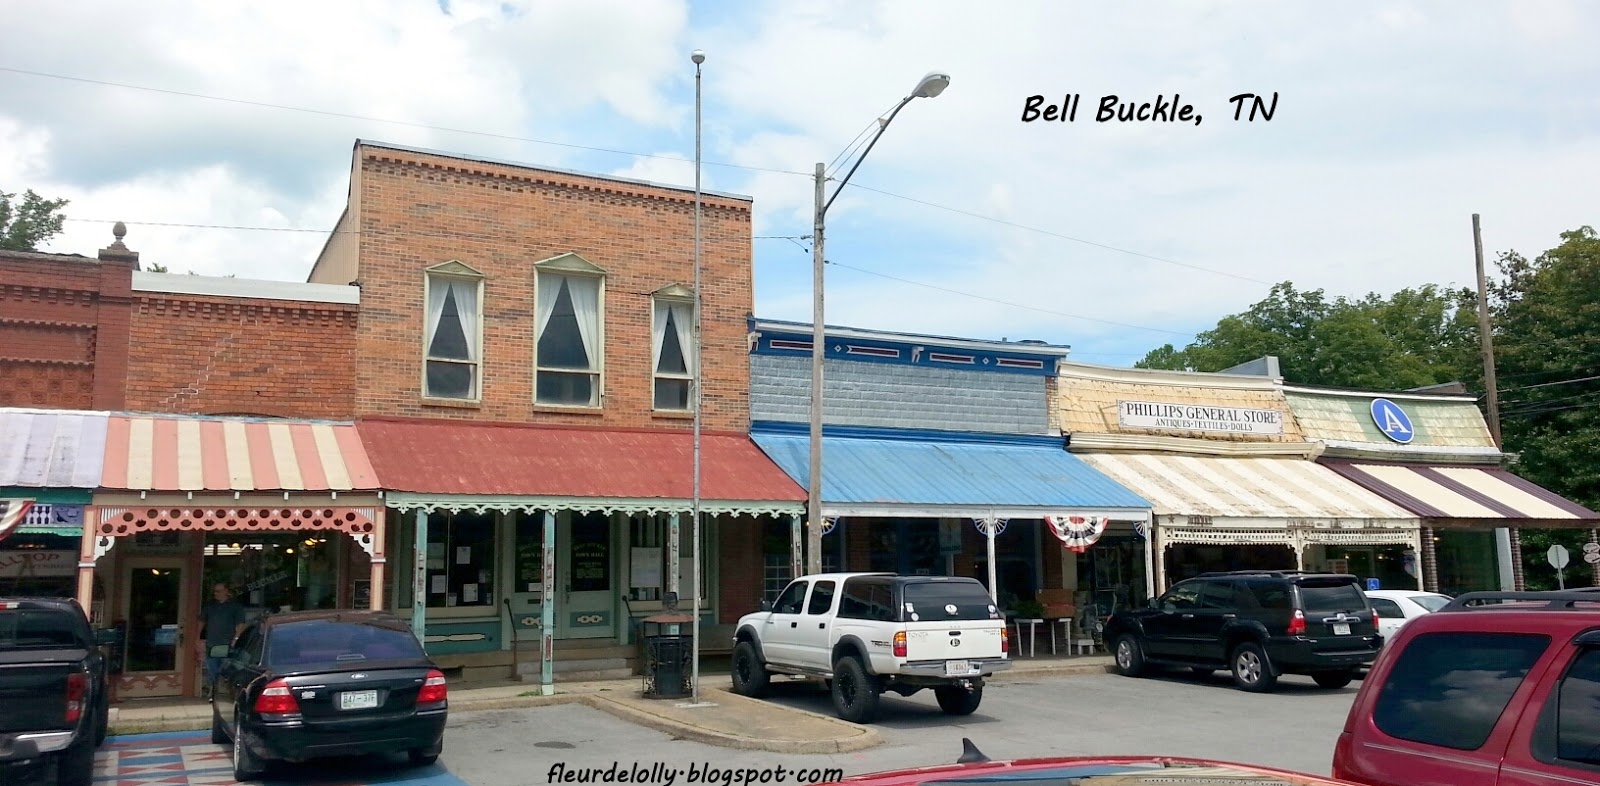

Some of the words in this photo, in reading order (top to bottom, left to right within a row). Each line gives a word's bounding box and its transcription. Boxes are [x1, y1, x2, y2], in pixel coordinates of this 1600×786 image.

[1186, 406, 1242, 422] GENERAL
[1243, 410, 1278, 424] STORE
[1383, 404, 1412, 434] A
